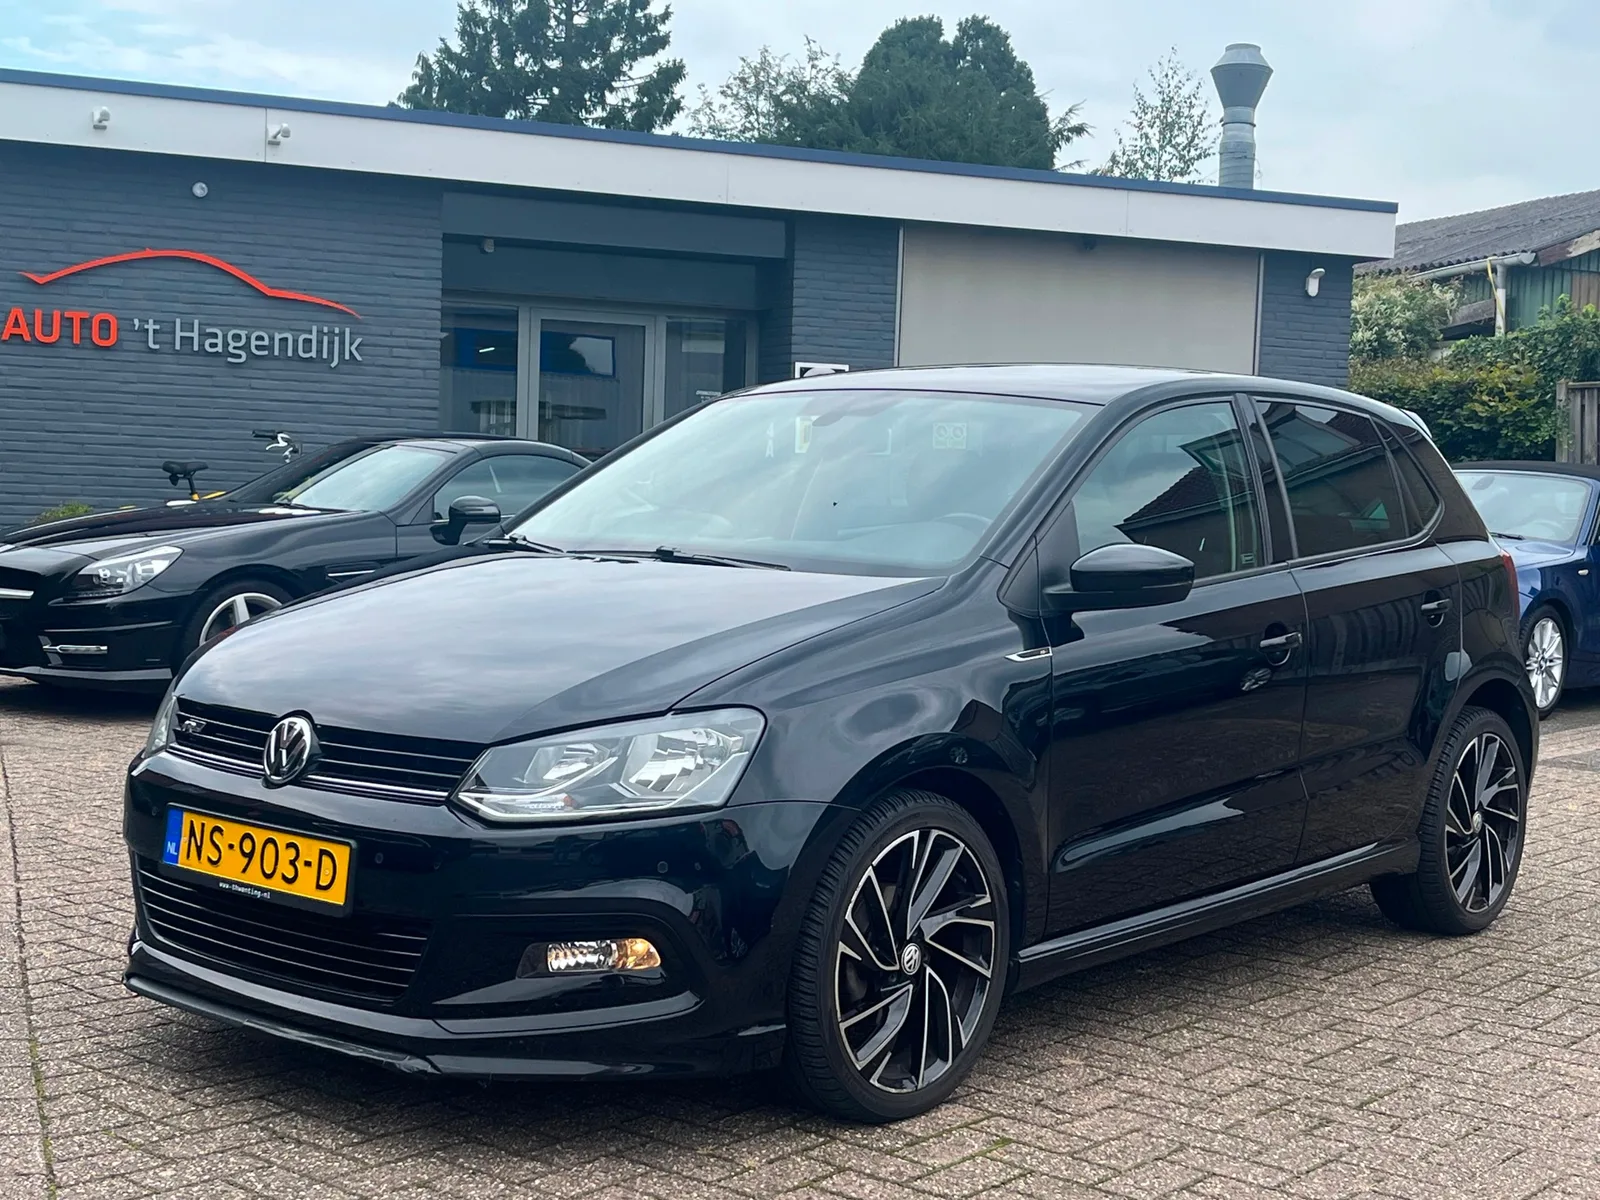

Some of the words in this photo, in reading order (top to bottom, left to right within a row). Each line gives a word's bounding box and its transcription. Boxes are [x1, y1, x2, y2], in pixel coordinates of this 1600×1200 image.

[2, 308, 118, 347] AUTO
[174, 318, 363, 368] Hagendijk
[166, 841, 178, 856] NL
[186, 819, 337, 891] NS-903-D
